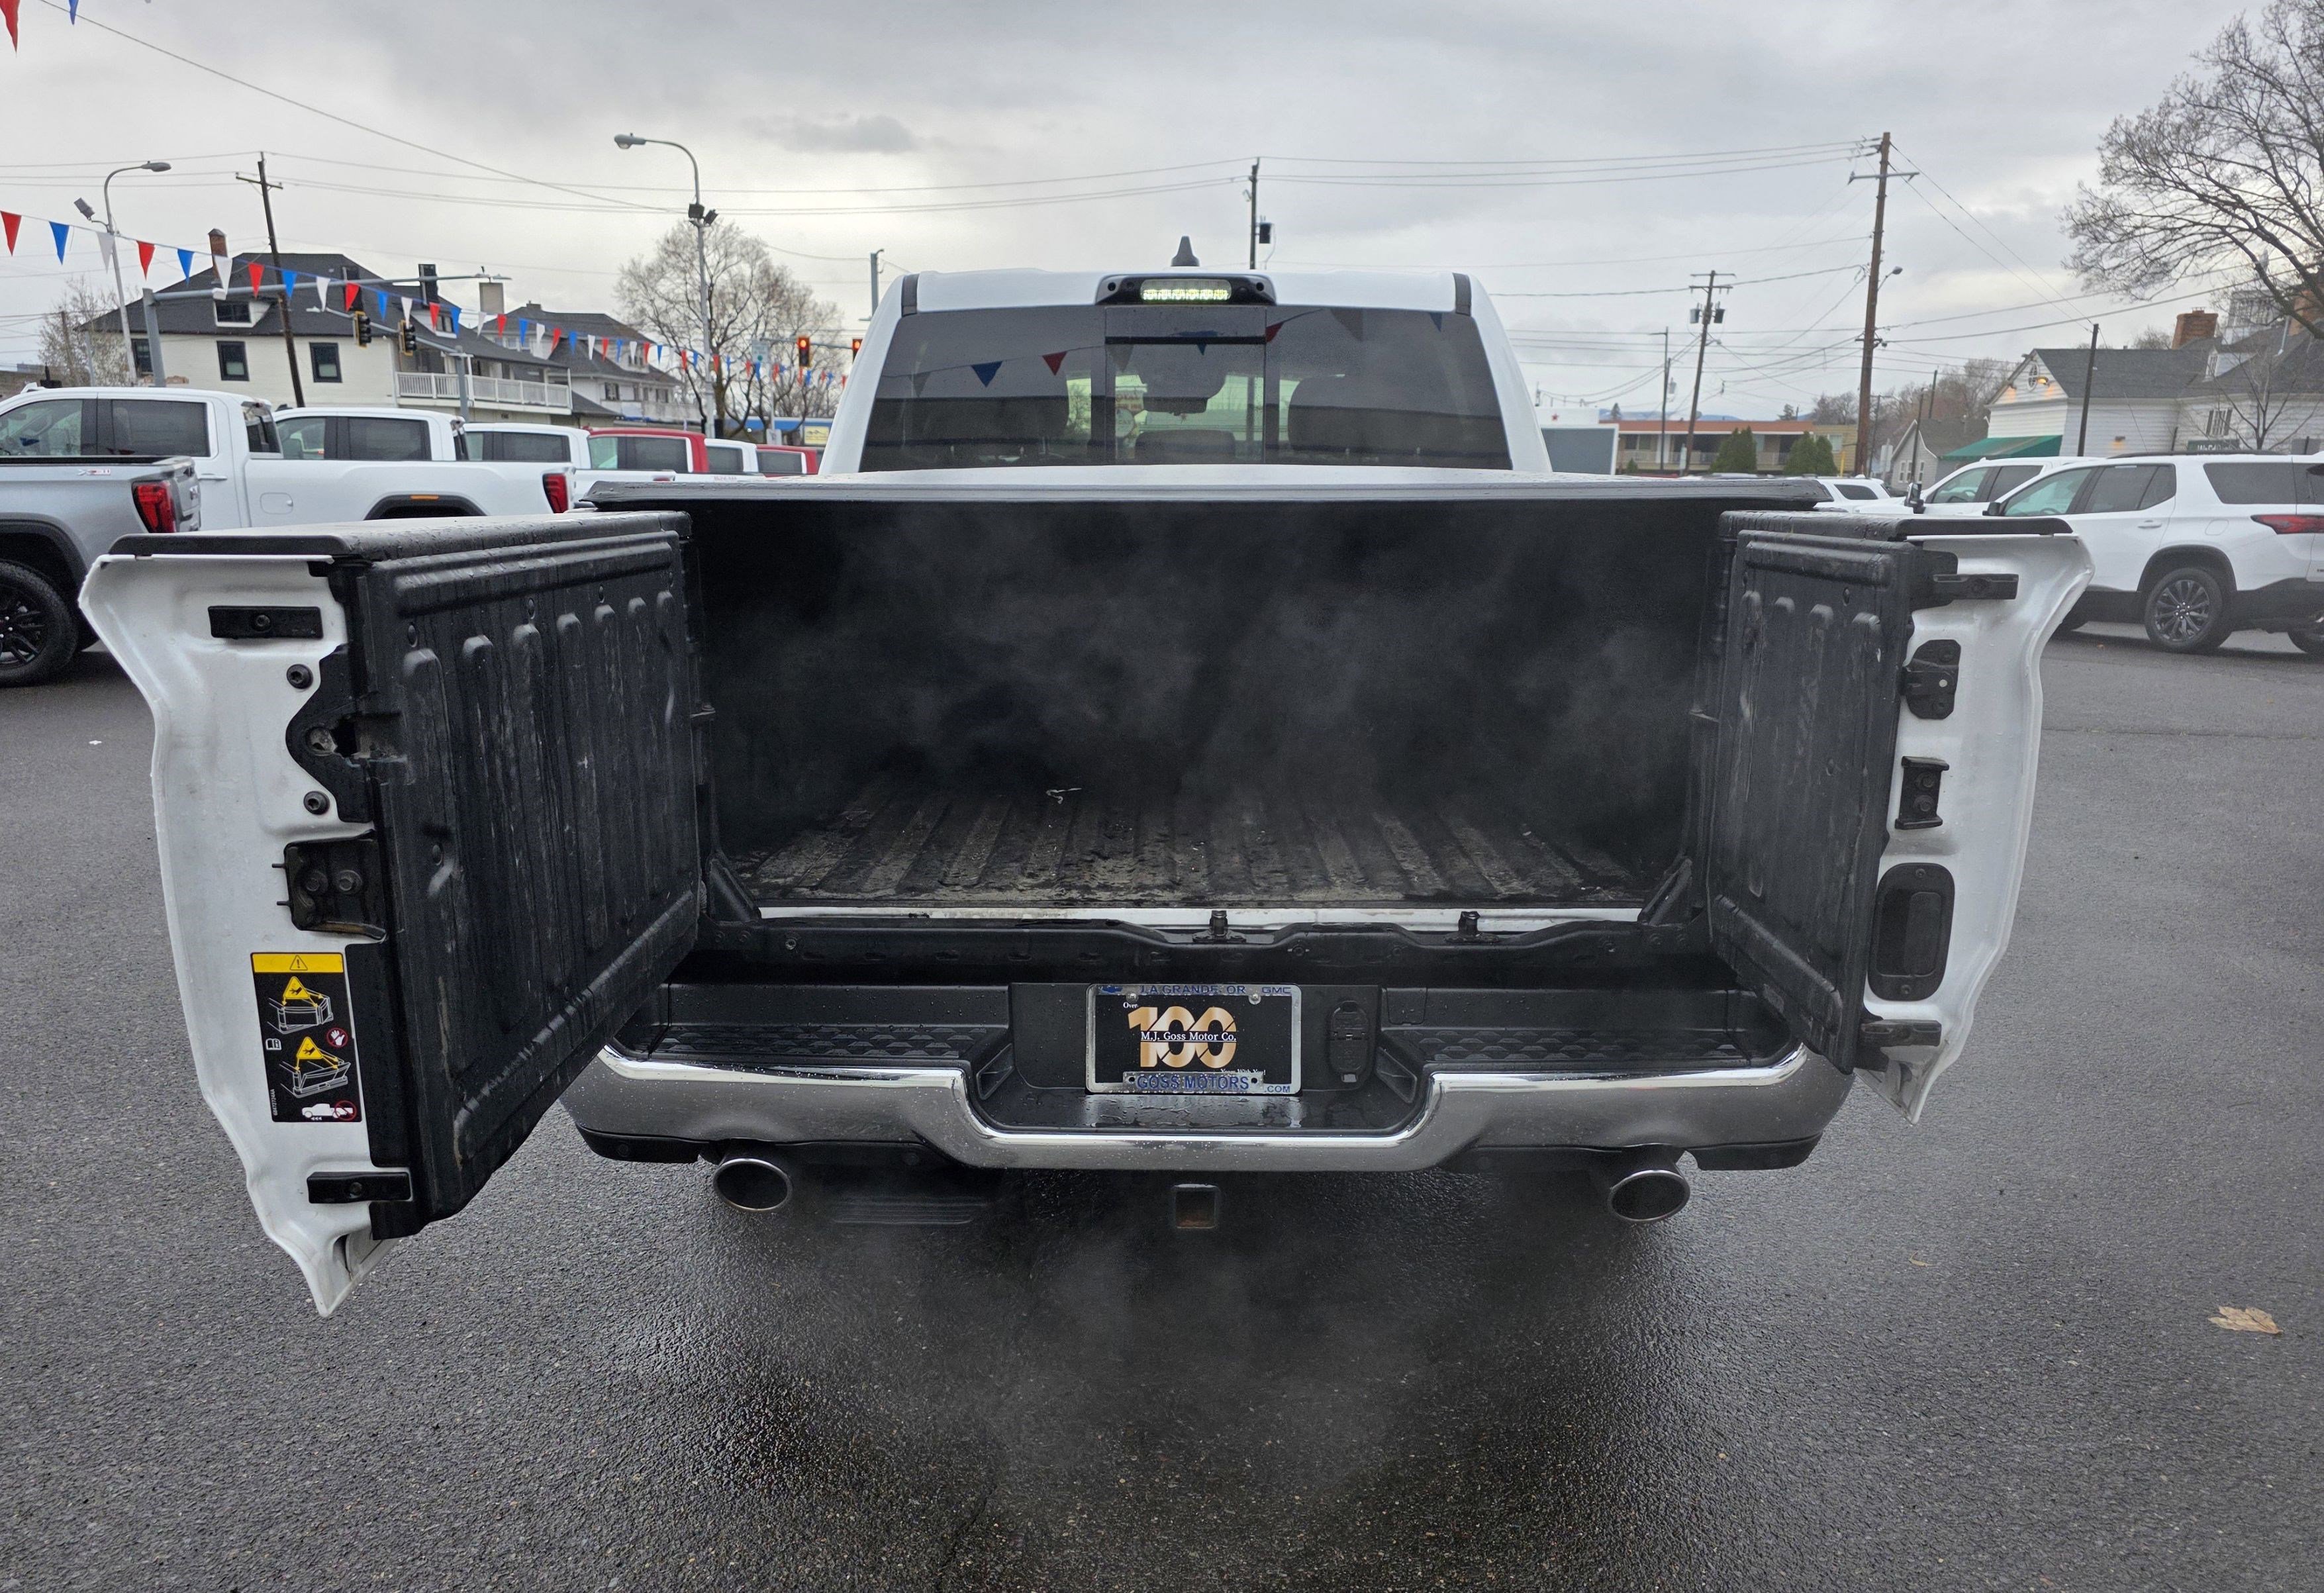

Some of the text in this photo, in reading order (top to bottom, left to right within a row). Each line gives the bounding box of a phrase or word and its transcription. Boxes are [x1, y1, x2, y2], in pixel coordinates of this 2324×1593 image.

[1128, 1006, 1236, 1068] 100
[1141, 1032, 1237, 1041] M.J. Goss Motor Co.
[1137, 1075, 1179, 1089] GOSS
[1185, 1076, 1249, 1090] MOTORS
